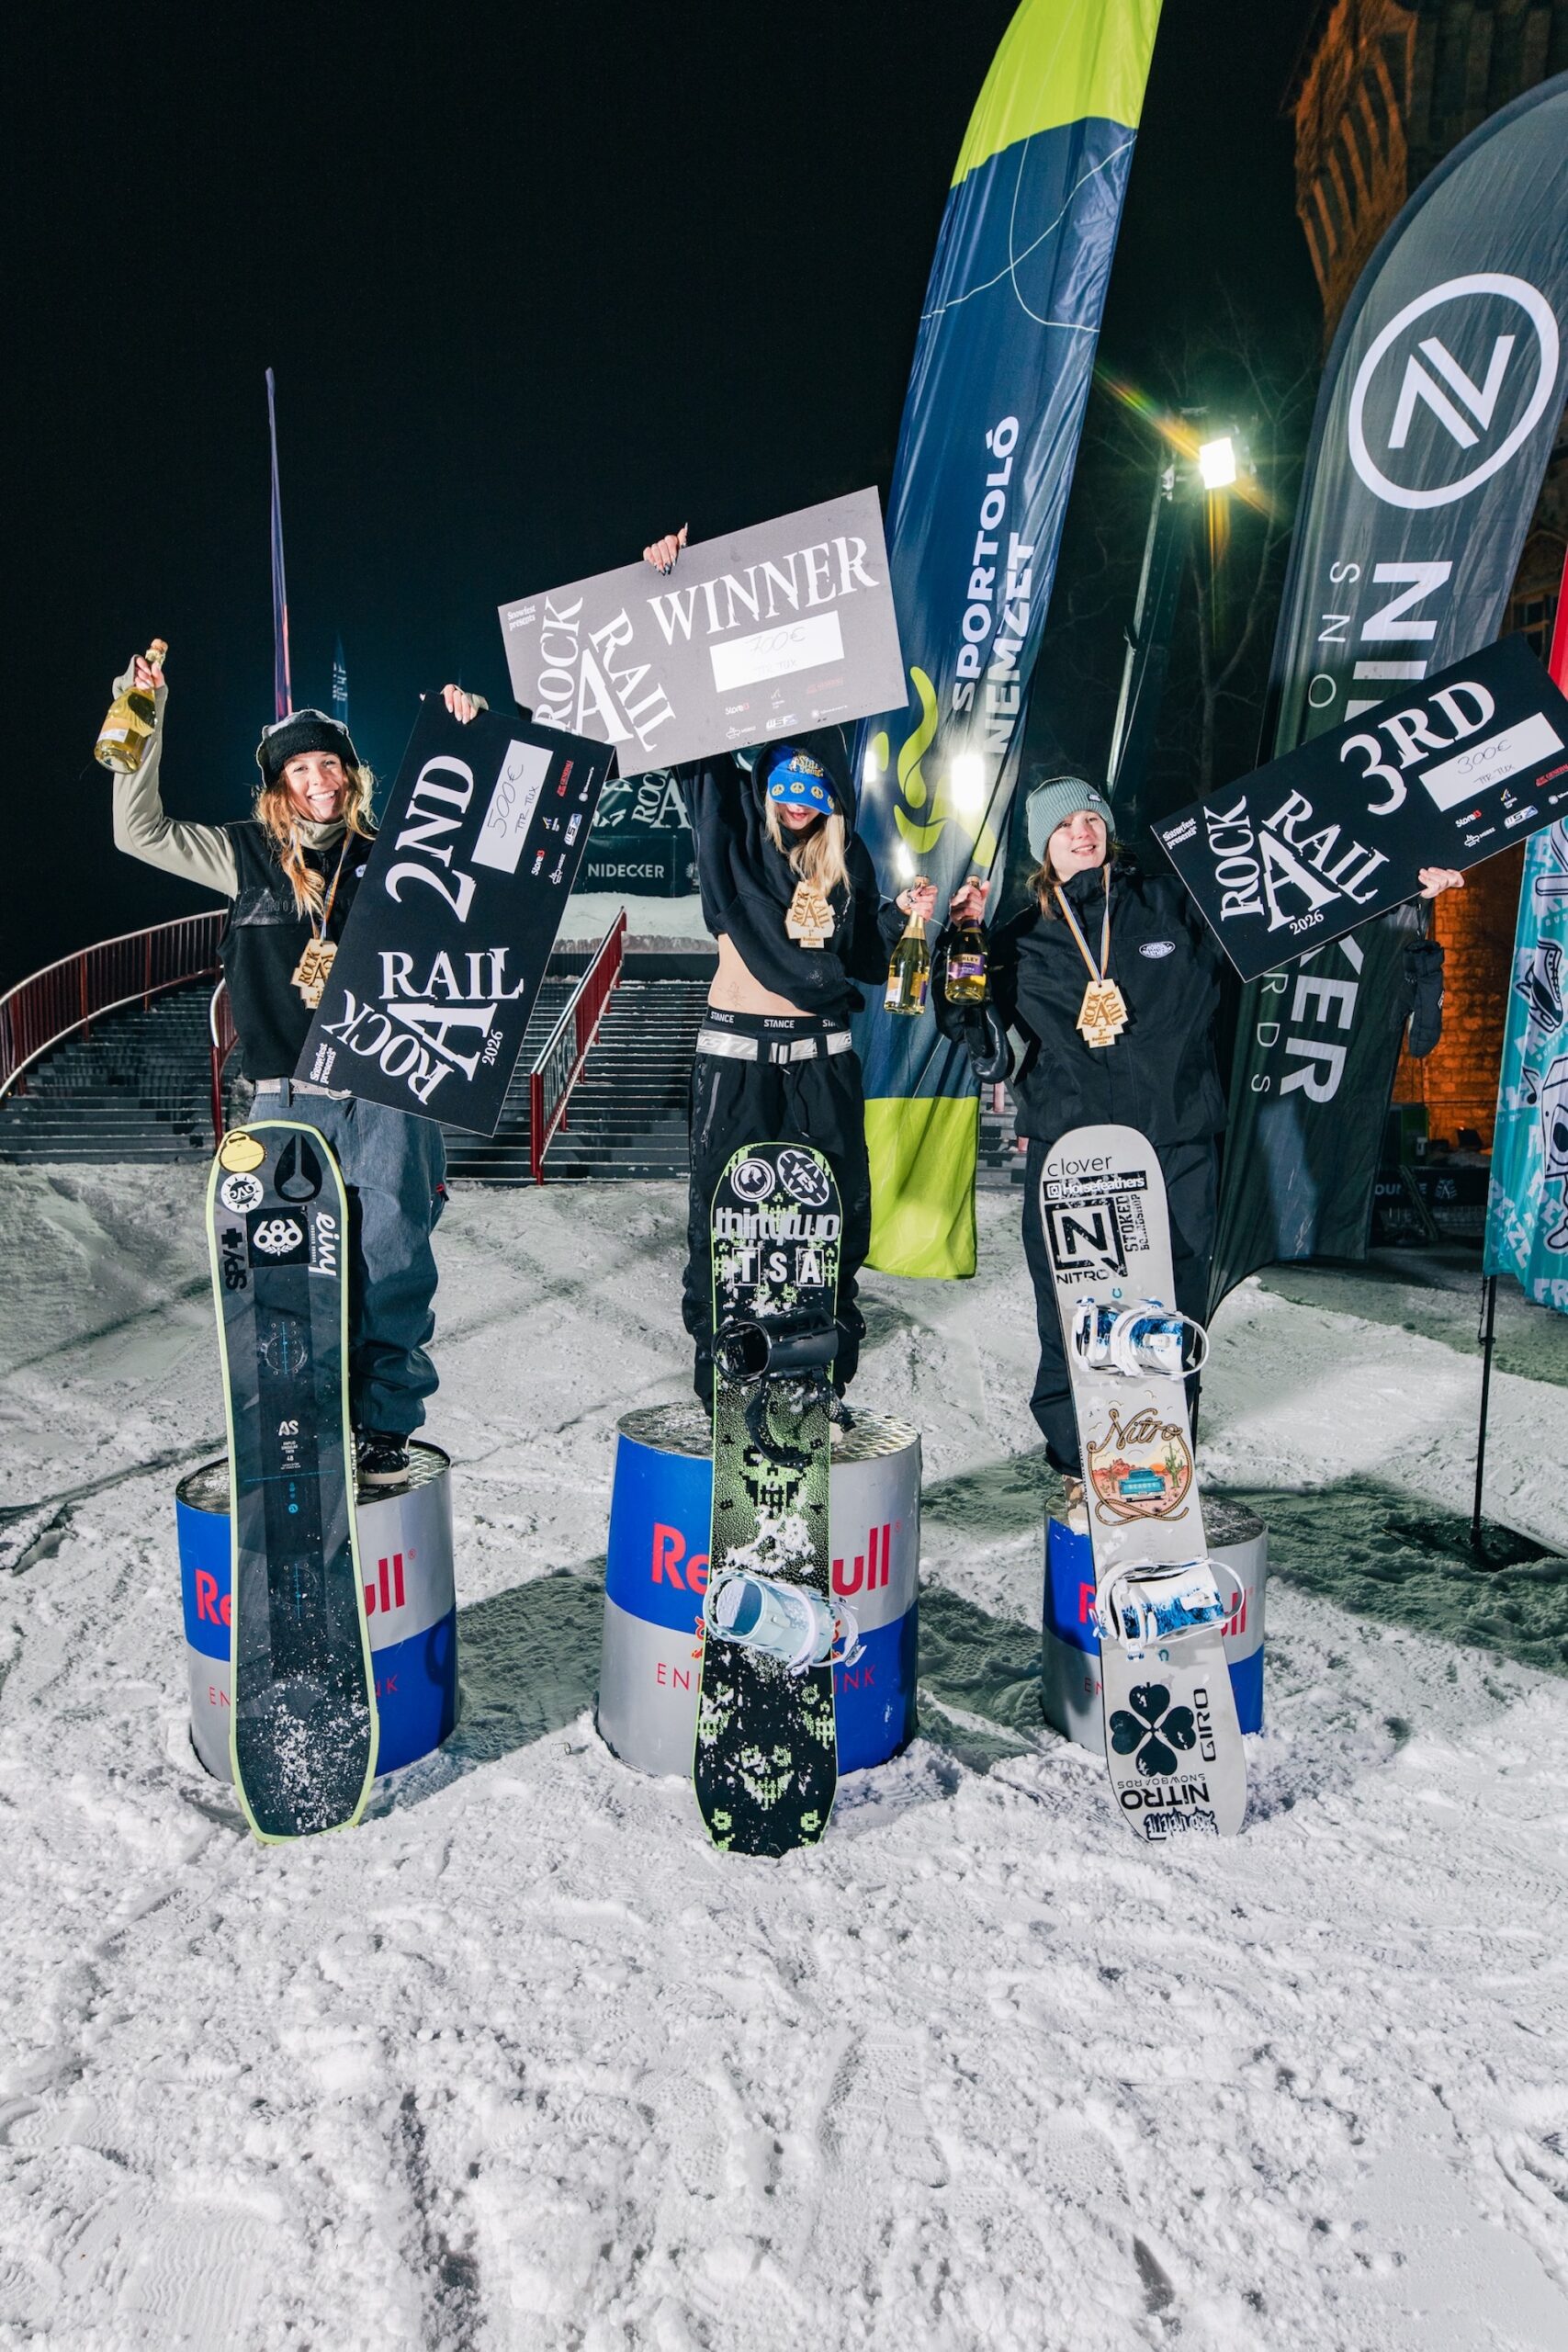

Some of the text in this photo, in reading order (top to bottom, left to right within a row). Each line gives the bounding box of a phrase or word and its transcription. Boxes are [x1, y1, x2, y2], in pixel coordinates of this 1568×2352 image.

[647, 537, 880, 645] WINNER
[952, 416, 1020, 711] SPORTOLÓ
[532, 595, 583, 732] ROCK
[984, 532, 1034, 753] NEMZET
[570, 645, 634, 745] A
[588, 608, 676, 752] RAIL
[1340, 681, 1495, 815] 3RD
[1457, 740, 1512, 775] 300€
[487, 763, 525, 839] 500€
[649, 778, 694, 829] A
[1163, 818, 1196, 840] Snowfest
[1251, 561, 1360, 1092] SNORDS
[1280, 560, 1452, 1102] NIER
[385, 755, 477, 923] 2ND
[1203, 795, 1264, 922] ROCK
[1261, 789, 1390, 904] RAIL
[588, 864, 665, 878] NIDECKER
[1258, 831, 1342, 933] A
[1289, 910, 1325, 935] 2026
[378, 948, 525, 1001] RAIL
[321, 989, 455, 1105] ROCK
[387, 1002, 497, 1081] A
[481, 1029, 504, 1067] 2026
[710, 1011, 795, 1030] STANCE STANCE
[310, 1043, 329, 1081] Snowfest
[790, 1162, 818, 1193] YES
[1047, 1155, 1113, 1178] clover
[1062, 1176, 1145, 1194] Horsefeathers
[715, 1206, 840, 1246] thirtytwo
[1116, 1194, 1140, 1252] STOKED
[1056, 1269, 1110, 1285] NITRO
[278, 1419, 299, 1437] AS
[1087, 1408, 1183, 1453] Nitro
[651, 1521, 891, 1597] Re ull
[194, 1567, 231, 1627] Re
[1193, 1688, 1217, 1763] GIRO
[1120, 1782, 1212, 1811] NITRO
